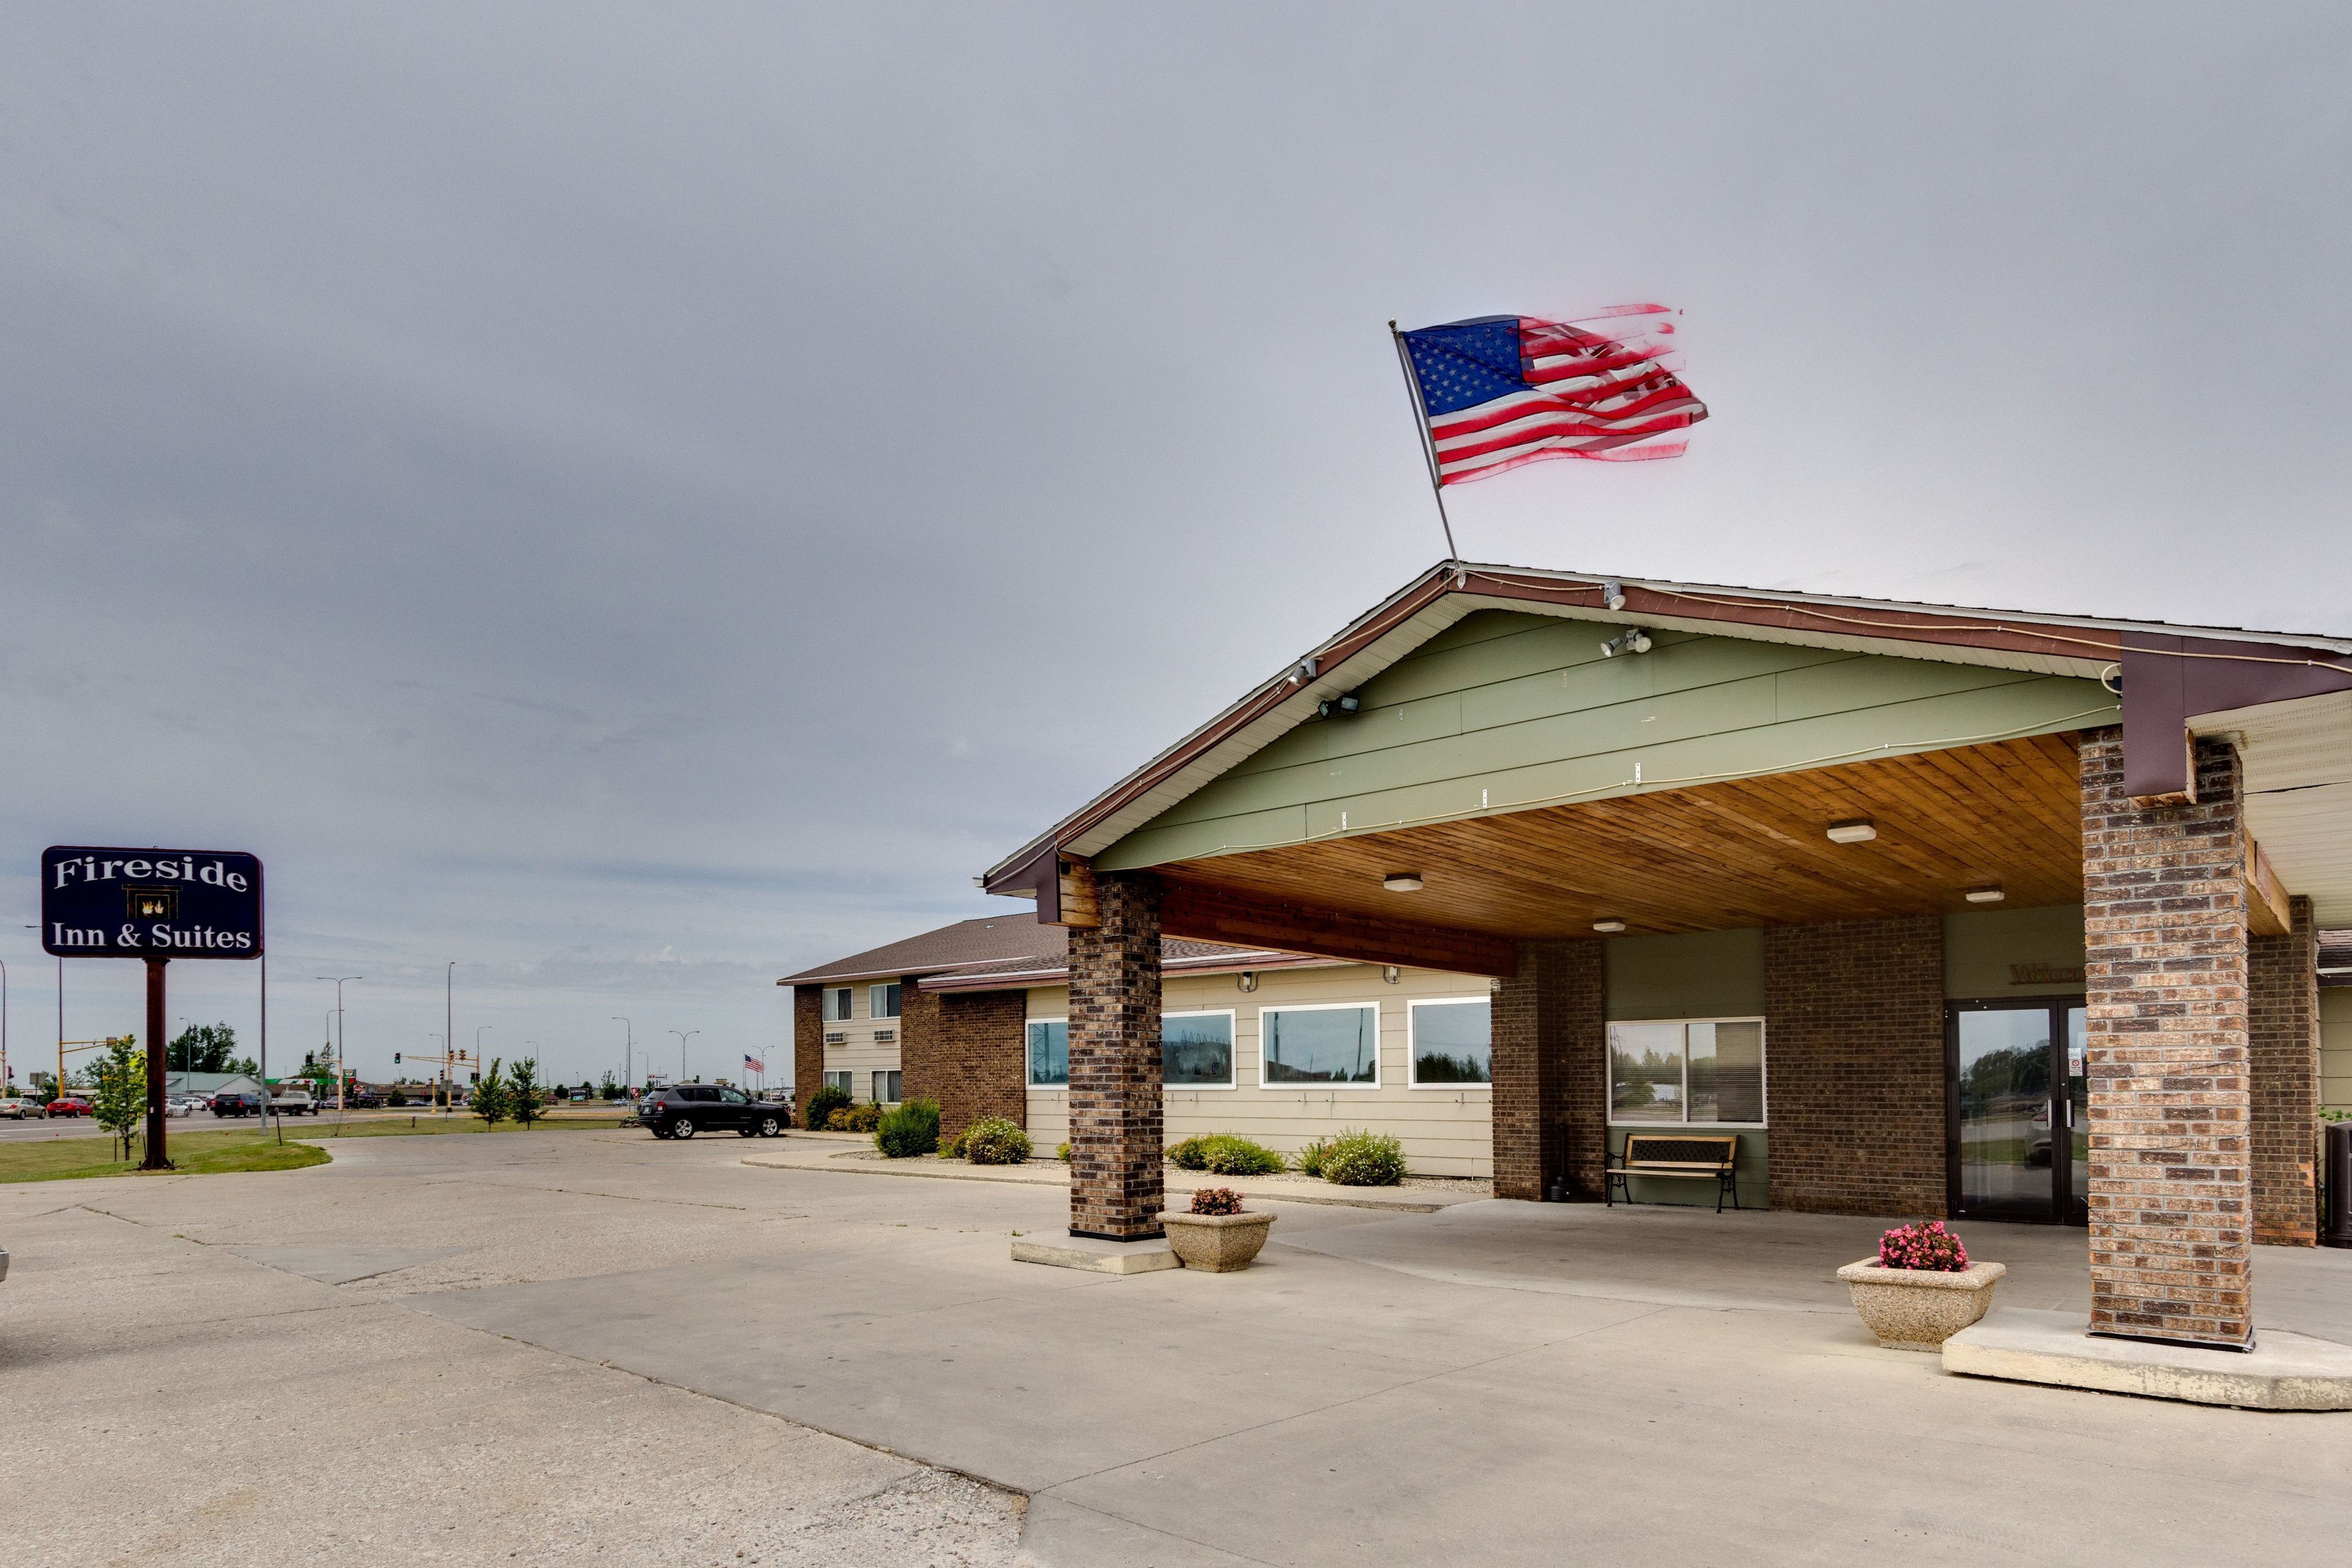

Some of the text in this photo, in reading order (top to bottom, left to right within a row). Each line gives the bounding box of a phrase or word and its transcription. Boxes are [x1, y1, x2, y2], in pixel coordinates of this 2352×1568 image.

[54, 856, 248, 892] Fireside
[51, 922, 252, 949] Inn & Suites
